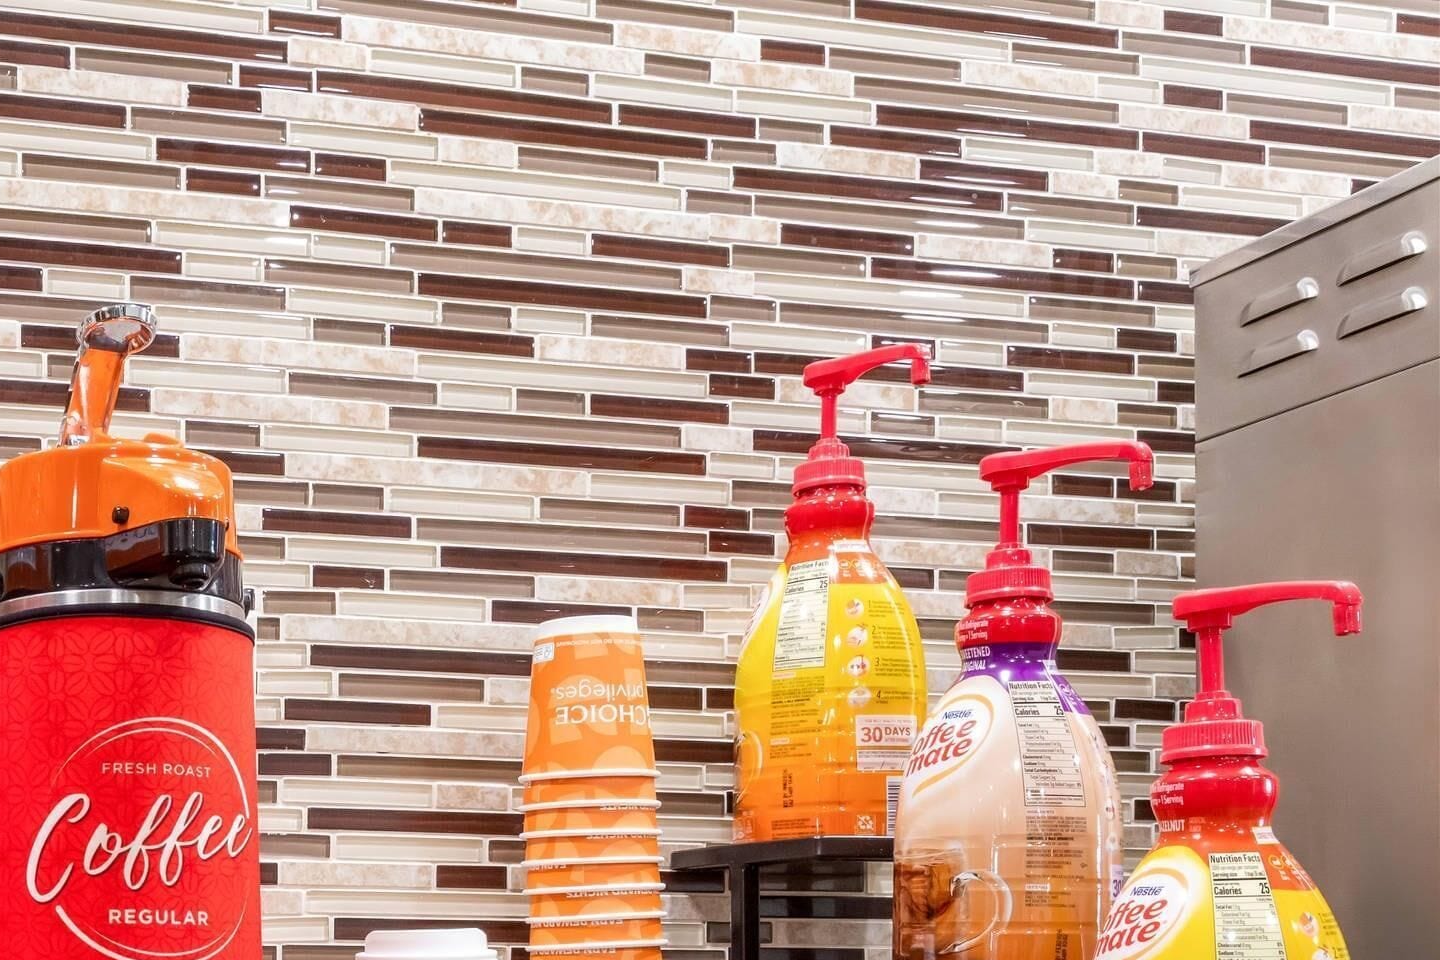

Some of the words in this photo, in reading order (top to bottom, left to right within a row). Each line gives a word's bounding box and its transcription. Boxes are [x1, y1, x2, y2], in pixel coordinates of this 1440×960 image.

[819, 580, 828, 589] 25
[555, 678, 644, 703] privileges
[1009, 682, 1037, 690] Nutrition
[555, 704, 647, 726] CHOICE
[860, 727, 883, 743] 30
[884, 727, 911, 736] DAYS
[912, 719, 977, 755] offee
[905, 737, 973, 777] mate
[101, 762, 157, 775] FRESH
[163, 764, 211, 778] ROAST
[25, 791, 253, 904] Coffee
[1210, 855, 1243, 863] Nutrition
[1243, 854, 1261, 863] Facts
[1214, 886, 1242, 896] Calories
[1259, 883, 1270, 894] 25
[108, 908, 209, 926] REGULAR
[1102, 899, 1168, 934] offee
